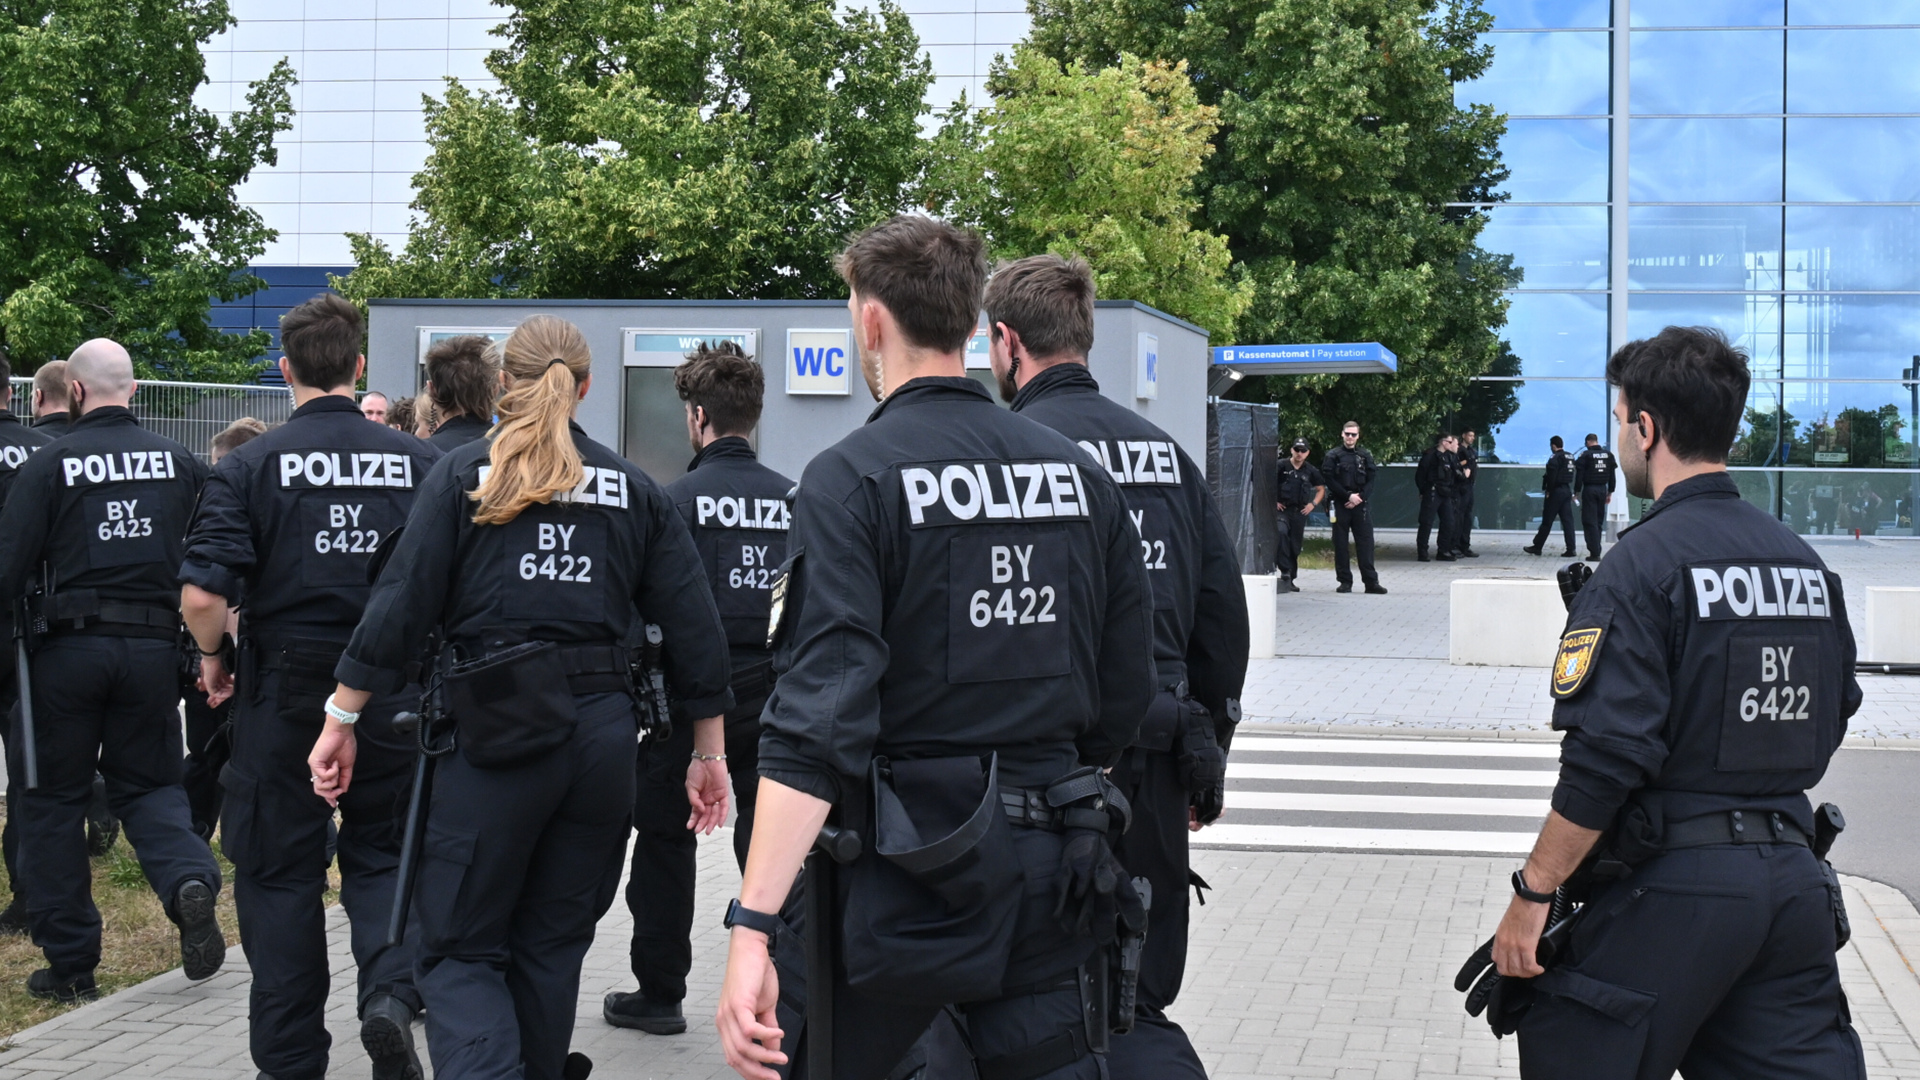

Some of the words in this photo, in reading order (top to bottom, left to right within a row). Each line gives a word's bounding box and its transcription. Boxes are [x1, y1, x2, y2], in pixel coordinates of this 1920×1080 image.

[678, 337, 701, 349] WC
[1239, 350, 1310, 359] Kassenautomat
[1317, 349, 1333, 359] Pay
[1335, 349, 1366, 357] station
[793, 347, 844, 377] WC
[1146, 351, 1157, 383] WC
[62, 451, 175, 486] POLIZEI
[280, 452, 413, 487] POLIZEI
[901, 464, 1089, 525] POLIZEI
[107, 499, 138, 521] BY
[329, 504, 363, 528] BY
[1129, 509, 1144, 539] Y
[98, 518, 152, 541] 6423
[315, 530, 379, 554] 6422
[538, 523, 576, 551] BY
[519, 553, 592, 583] 6422
[742, 545, 768, 567] BY
[991, 545, 1034, 584] BY
[969, 586, 1057, 628] 6422
[1691, 566, 1831, 618] POLIZEI
[1564, 634, 1595, 649] POLIZEI
[1762, 646, 1794, 682] BY
[1740, 685, 1810, 722] 6422
